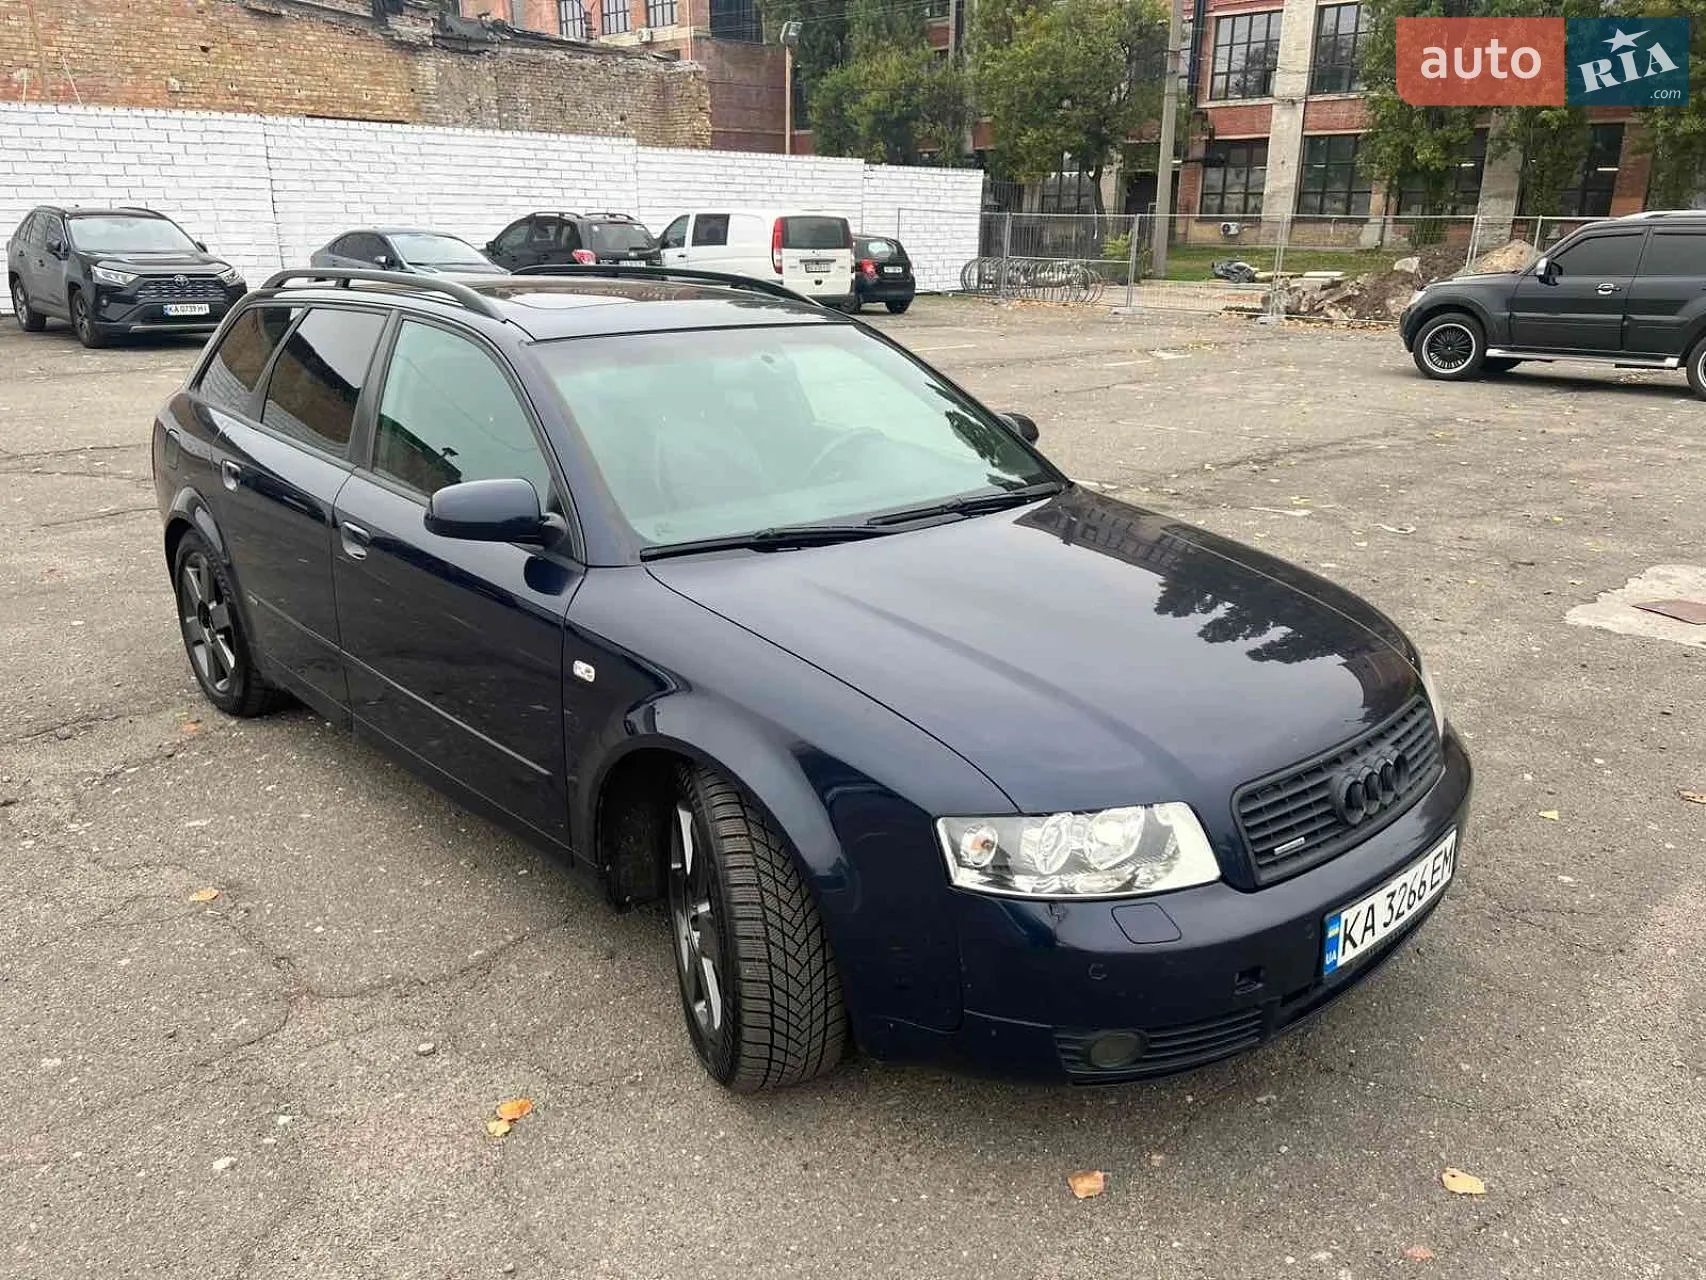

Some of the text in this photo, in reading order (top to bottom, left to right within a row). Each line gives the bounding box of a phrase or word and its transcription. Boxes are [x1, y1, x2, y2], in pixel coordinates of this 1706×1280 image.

[1342, 841, 1454, 957] KA 3266 EM
[1325, 950, 1337, 965] UA
